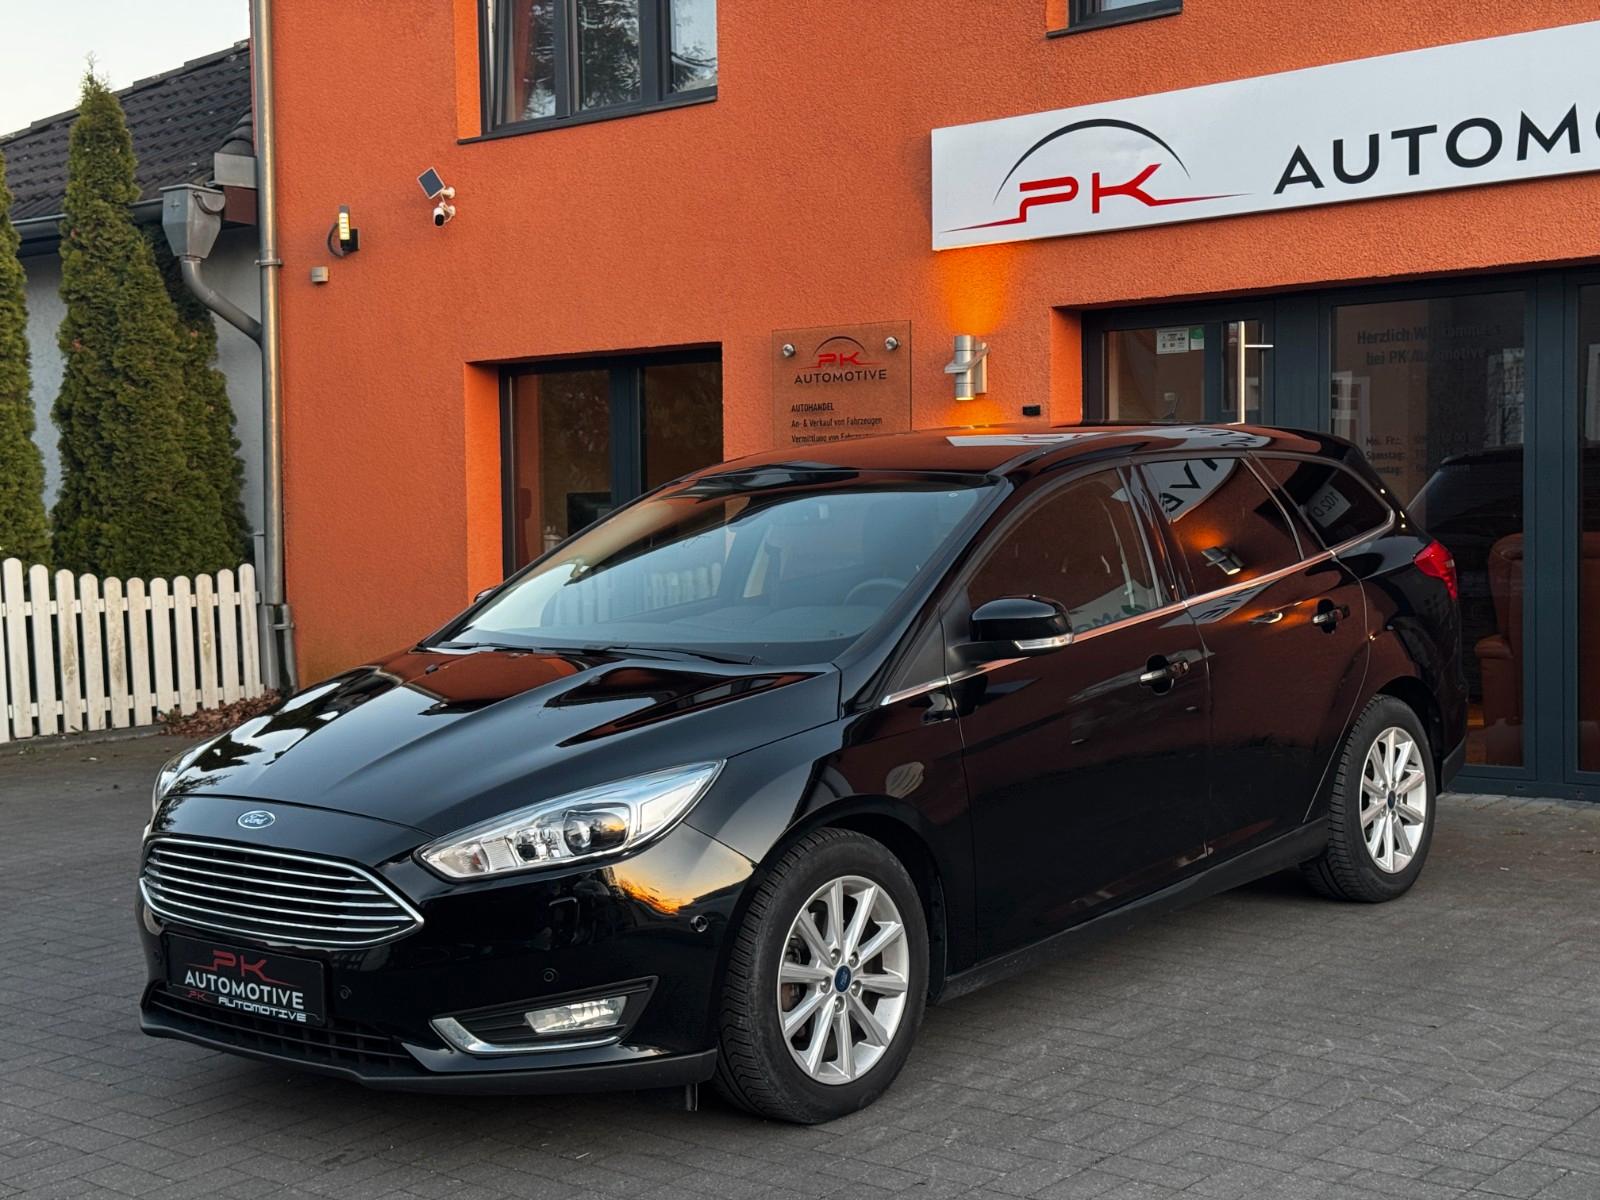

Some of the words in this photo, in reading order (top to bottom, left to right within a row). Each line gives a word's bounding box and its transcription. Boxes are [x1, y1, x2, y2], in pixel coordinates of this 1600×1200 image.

[1273, 103, 1600, 195] AUTOM
[817, 351, 861, 369] PK
[794, 369, 887, 385] AUTOMOTIVE
[791, 402, 834, 412] AUTOHANDEL
[809, 418, 833, 427] Verkauf
[210, 950, 267, 981] PK
[184, 970, 305, 1010] AUTOMOTIVE
[218, 996, 307, 1023] AUTOMOTIVE
